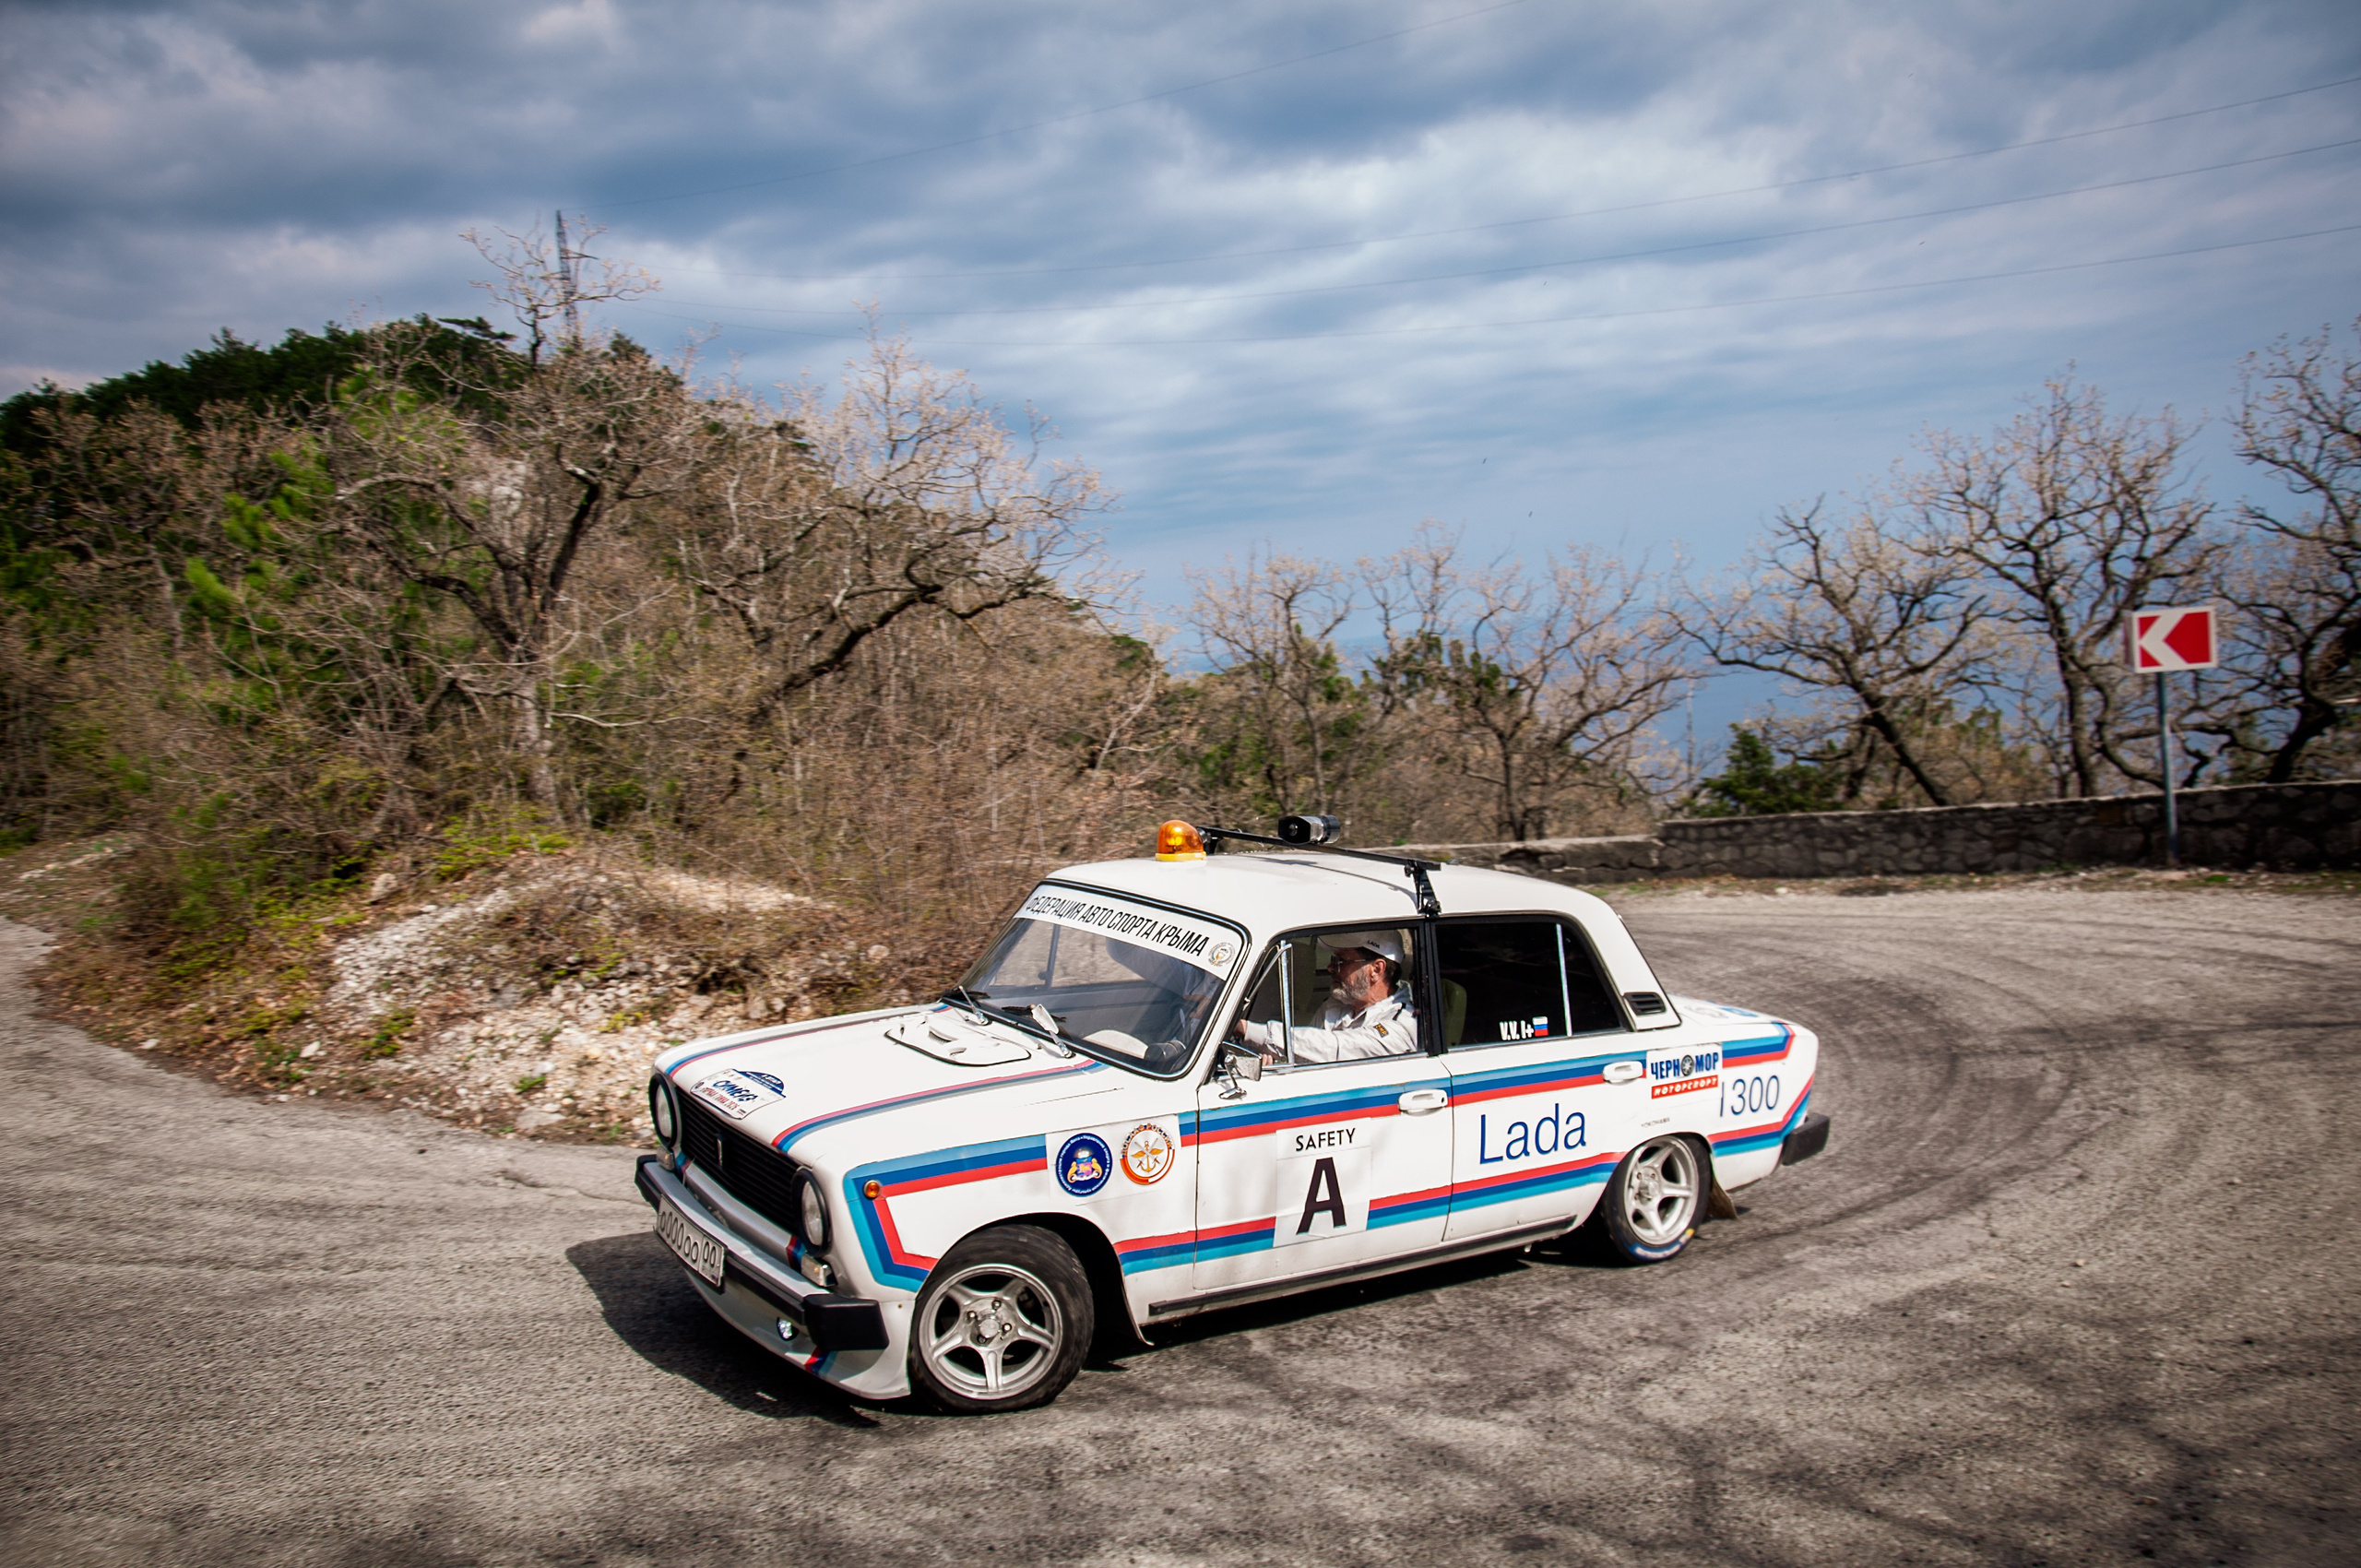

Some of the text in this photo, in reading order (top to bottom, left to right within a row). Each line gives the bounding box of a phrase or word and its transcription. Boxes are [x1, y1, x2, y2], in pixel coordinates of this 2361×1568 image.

[1026, 896, 1086, 920] ФЕДЕРАЦИЯ
[1078, 905, 1113, 927] АВТО
[1107, 911, 1158, 940] СПОРТА
[1152, 923, 1210, 956] КРЫМА
[1720, 1075, 1780, 1117] 1300
[1296, 1128, 1356, 1152] SAFETY
[1479, 1103, 1586, 1164] Lada
[1296, 1157, 1347, 1235] A
[703, 1241, 717, 1267] 00
